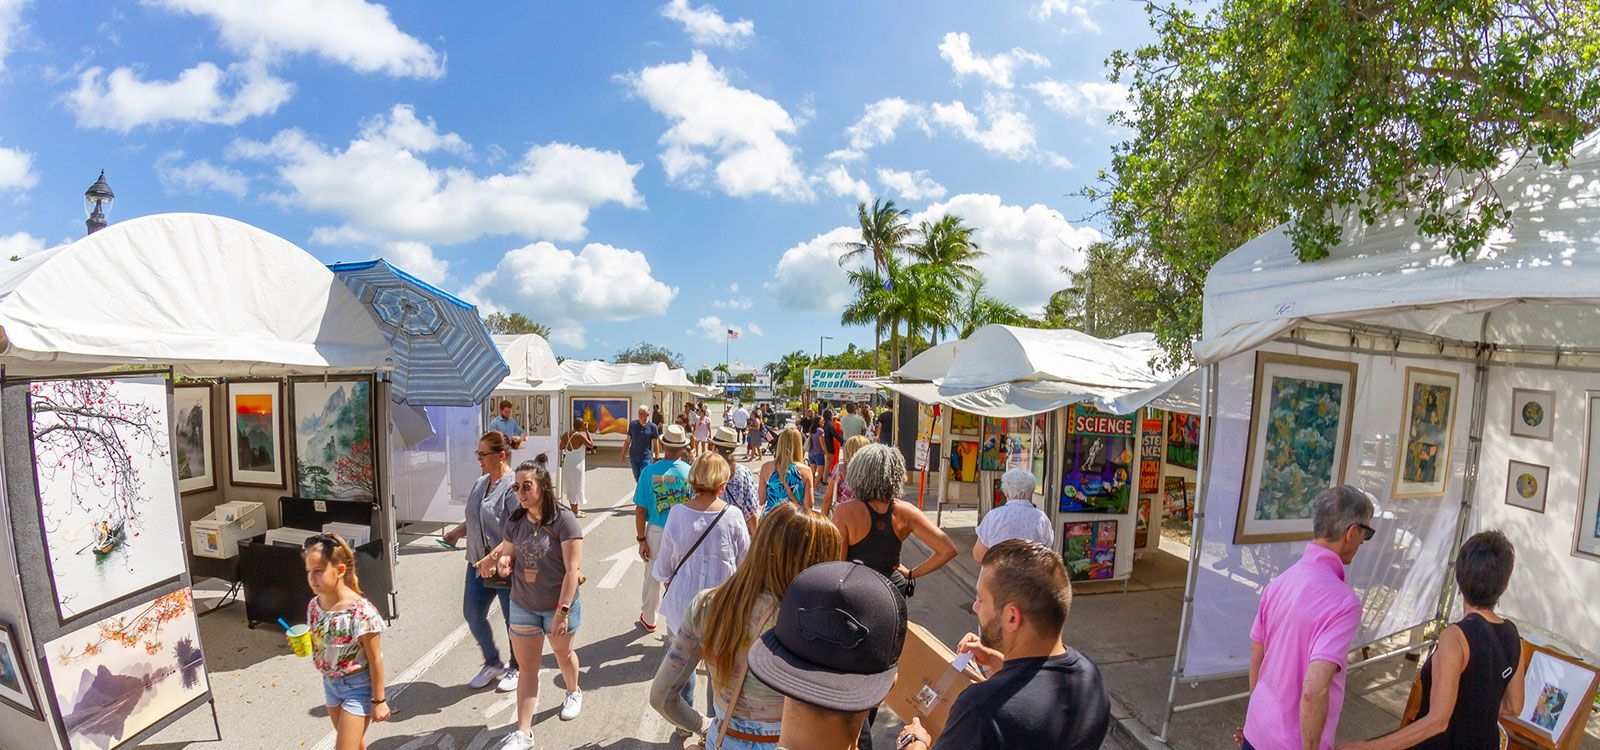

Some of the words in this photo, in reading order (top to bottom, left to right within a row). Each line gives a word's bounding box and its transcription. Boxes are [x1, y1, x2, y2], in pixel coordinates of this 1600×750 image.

[812, 369, 847, 379] Power
[1076, 415, 1133, 434] SCIENCE
[1142, 435, 1162, 447] STE
